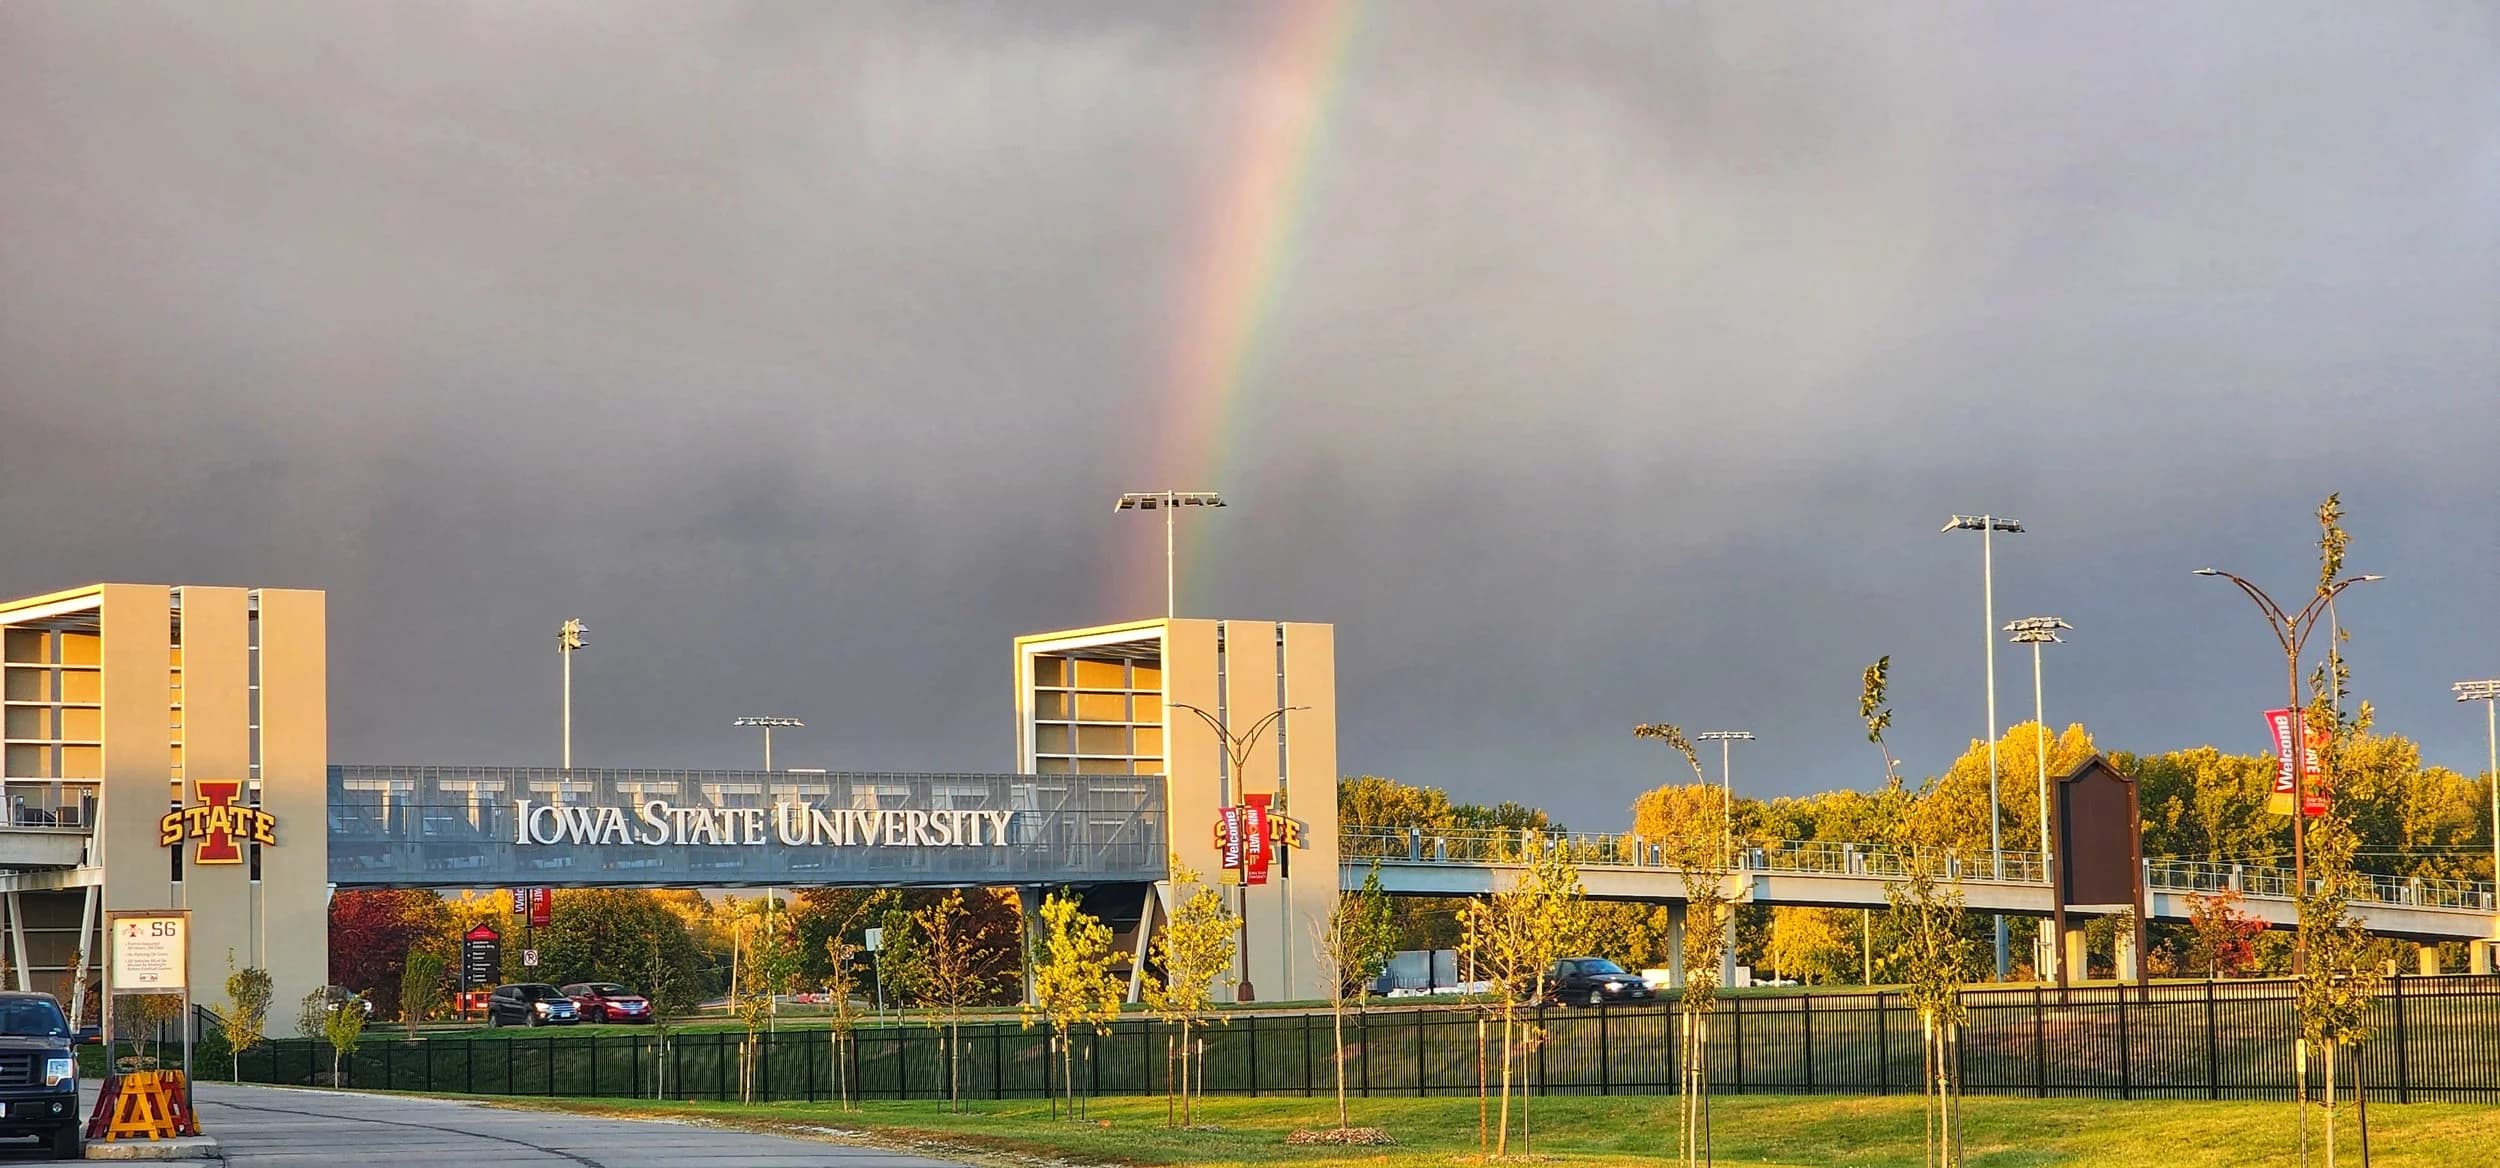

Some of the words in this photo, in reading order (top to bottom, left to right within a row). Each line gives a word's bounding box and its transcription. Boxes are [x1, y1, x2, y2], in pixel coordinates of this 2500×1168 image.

[2274, 716, 2293, 791] Welcome
[160, 805, 276, 847] STATE
[515, 799, 634, 845] IOWA
[640, 800, 767, 846] STATE
[774, 801, 1014, 846] UNIVERSITY
[1215, 814, 1302, 850] STE
[1224, 811, 1239, 868] Welcome
[1247, 809, 1260, 854] INNOVATE
[151, 921, 176, 937] S6
